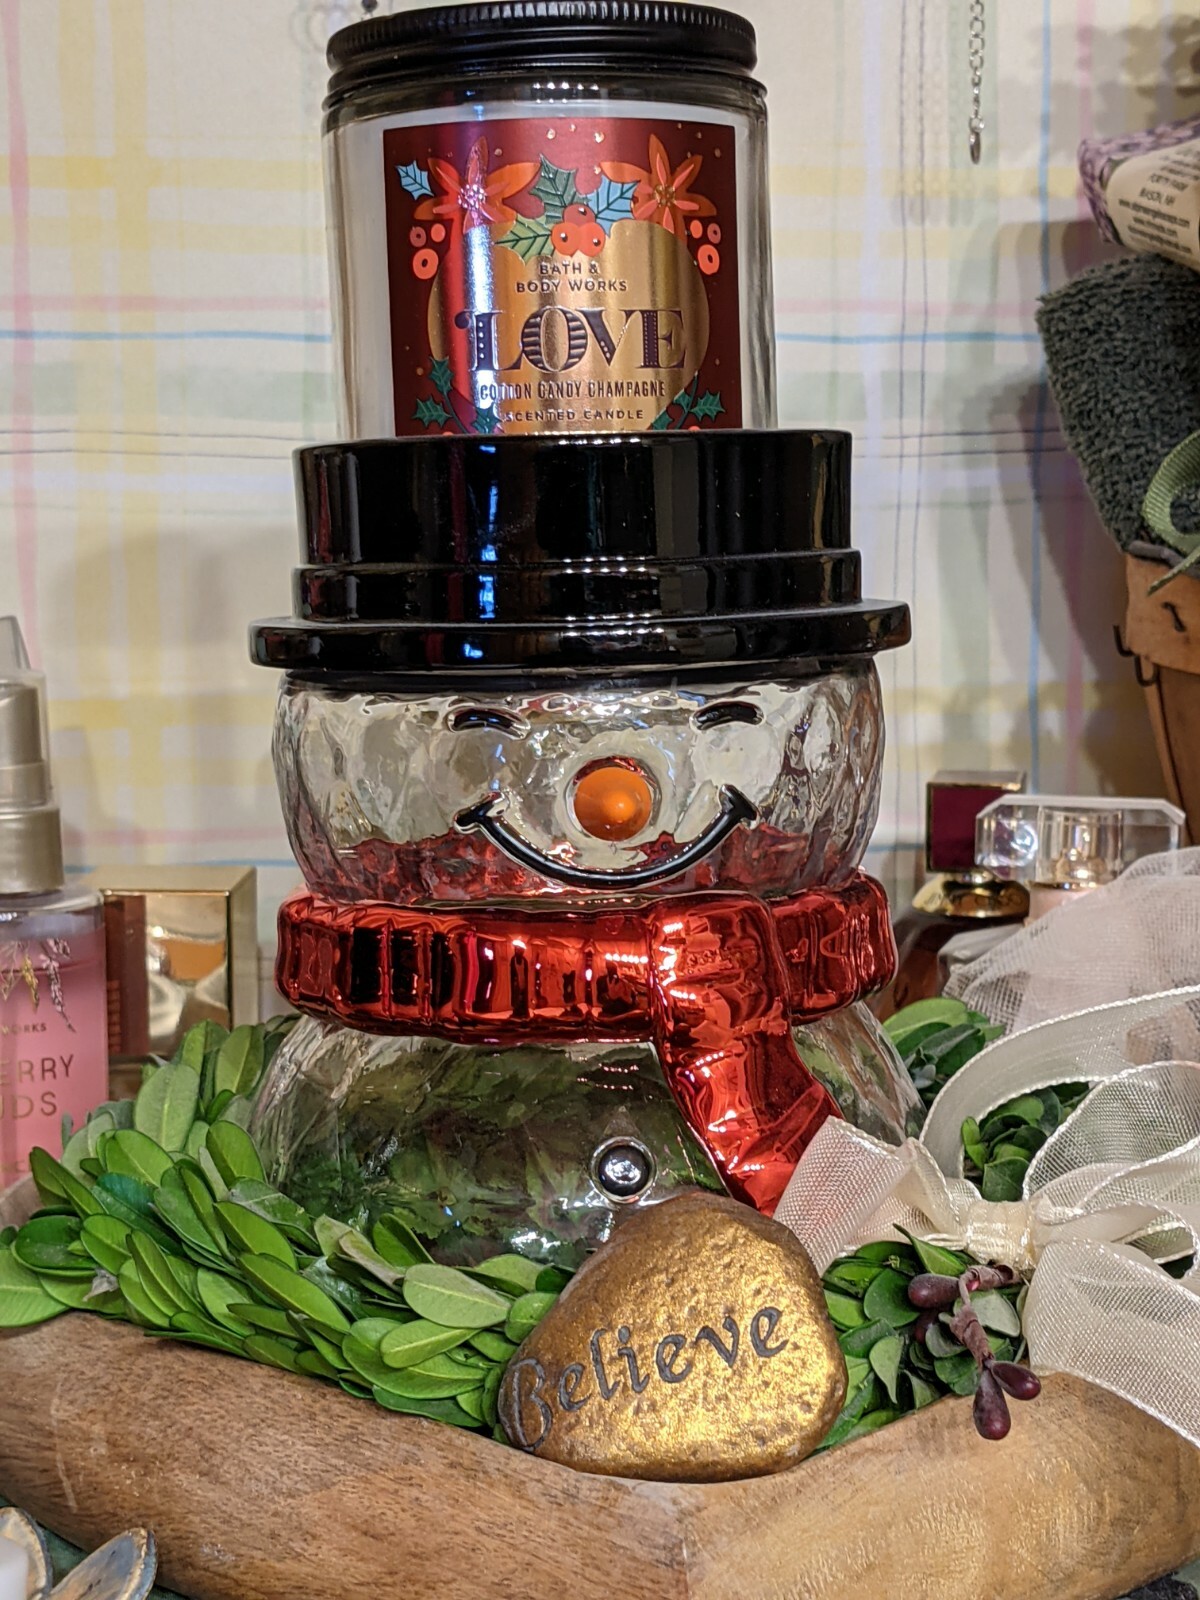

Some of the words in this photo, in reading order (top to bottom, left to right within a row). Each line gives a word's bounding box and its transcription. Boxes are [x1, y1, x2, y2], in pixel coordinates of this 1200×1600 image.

[539, 262, 583, 276] BATH
[588, 262, 600, 275] &
[516, 280, 561, 293] BODY
[569, 279, 627, 292] WORKS
[454, 305, 687, 374] LOVE
[480, 383, 532, 401] COTTON
[538, 381, 583, 399] CANDY
[588, 380, 666, 399] CHAMPAGNE
[503, 410, 576, 423] SCENTED
[583, 409, 644, 421] CANDLE
[497, 1306, 790, 1451] Believe
